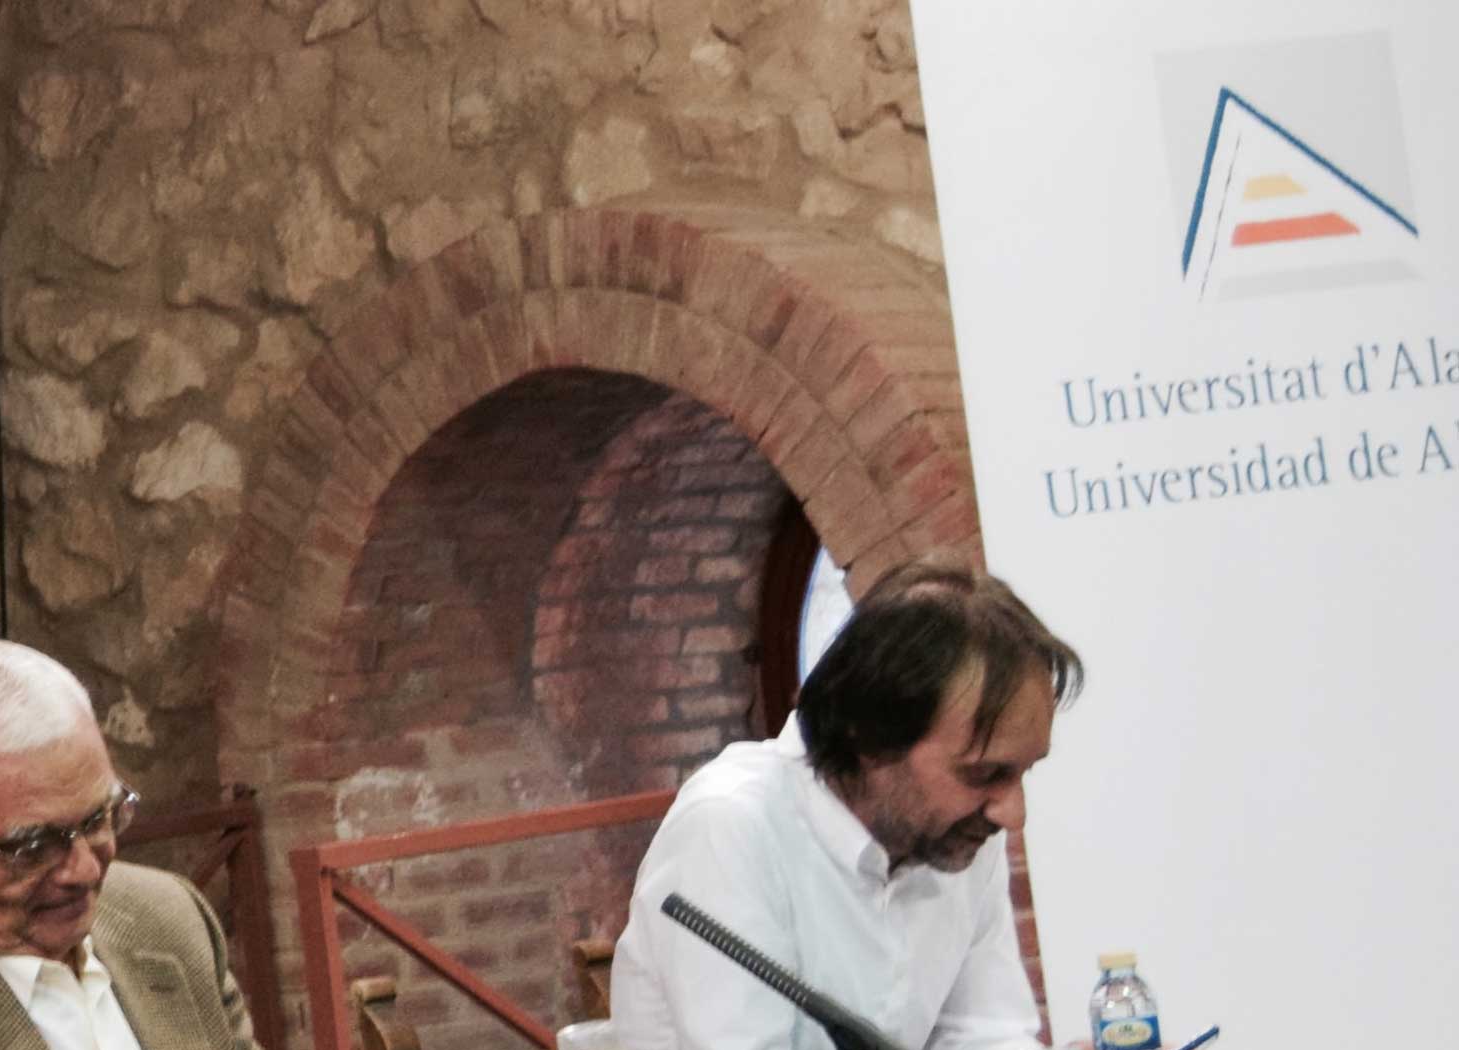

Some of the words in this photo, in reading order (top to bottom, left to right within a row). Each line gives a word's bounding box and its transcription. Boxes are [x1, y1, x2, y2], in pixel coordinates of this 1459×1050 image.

[1061, 357, 1325, 429] Universitat
[1043, 437, 1330, 519] Universidad
[1347, 430, 1400, 481] de
